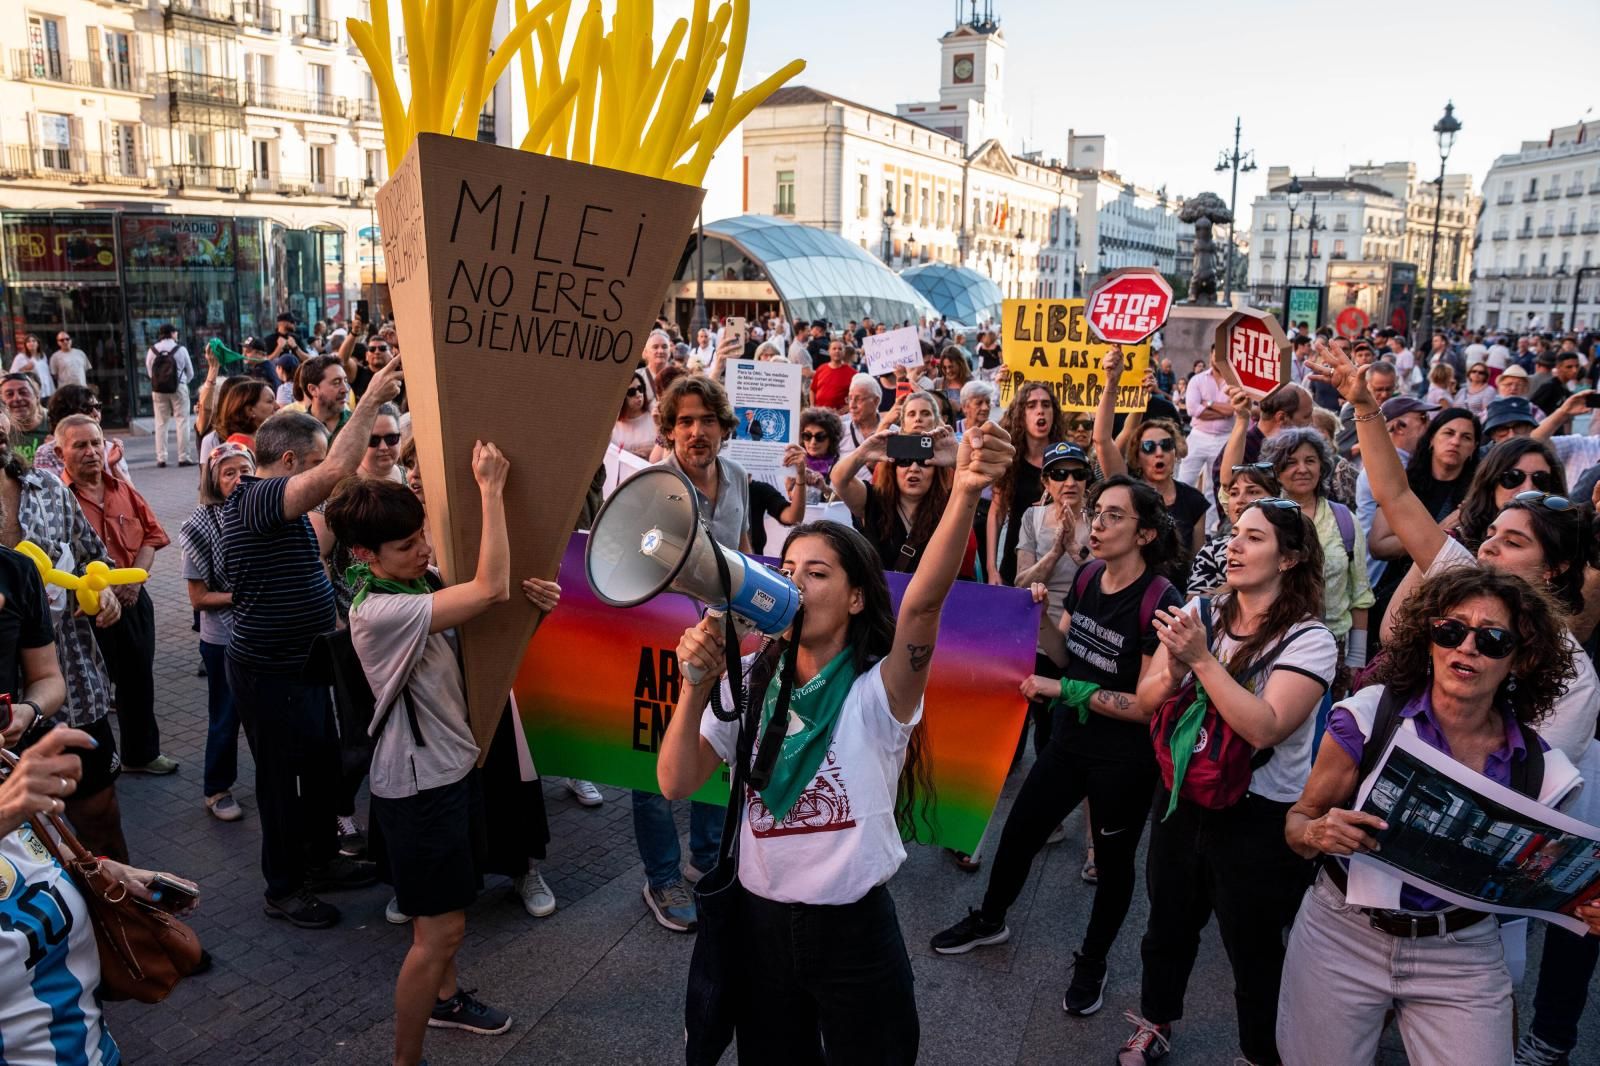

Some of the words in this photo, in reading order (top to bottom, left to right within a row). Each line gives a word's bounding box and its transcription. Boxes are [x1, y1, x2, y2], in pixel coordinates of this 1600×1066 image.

[171, 221, 218, 234] MADRID
[448, 259, 514, 307] NO
[532, 271, 625, 322] ERES
[1094, 293, 1161, 316] STOP
[1291, 300, 1317, 311] CERO
[1029, 347, 1049, 367] A
[1058, 348, 1089, 368] LAS
[757, 591, 775, 604] VONYX
[0, 881, 74, 971] 10
